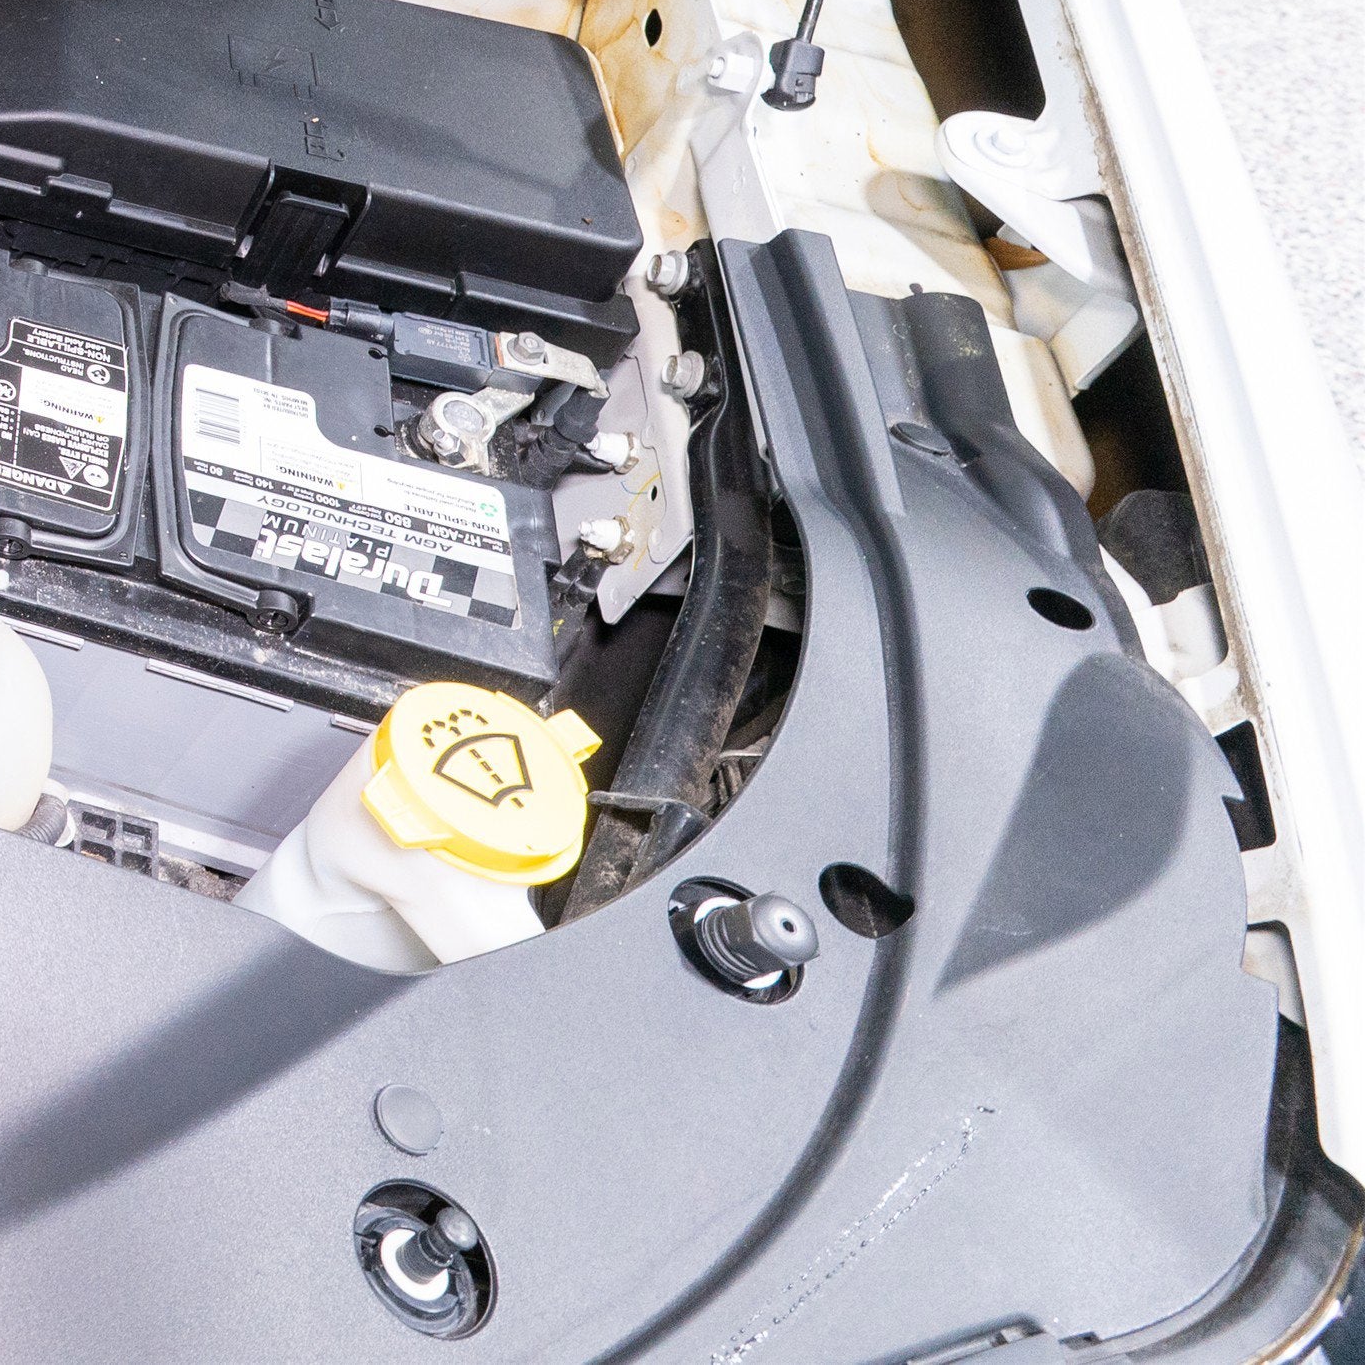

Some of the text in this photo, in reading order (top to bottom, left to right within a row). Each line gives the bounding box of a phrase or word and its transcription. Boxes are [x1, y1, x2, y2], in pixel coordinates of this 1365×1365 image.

[26, 333, 111, 362] NON-SPILLABLE
[31, 327, 106, 353] Lead Acid Battery
[22, 347, 84, 369] INSTRUCTIONS.
[60, 364, 83, 376] READ
[38, 399, 94, 420] WARNING:
[1, 430, 12, 439] NO
[22, 426, 40, 438] CAN
[34, 422, 109, 449] CAUSE BLINDNESS
[64, 425, 97, 440] INJURY.
[209, 464, 222, 476] 80
[275, 464, 333, 487] WARNING:
[255, 477, 273, 490] 140
[315, 493, 340, 507] 1000
[258, 495, 452, 553] AGM TECHNOLOGY
[384, 510, 412, 528] 850
[260, 512, 390, 558] PLATINUM
[426, 522, 481, 547] H7-AGM
[259, 526, 453, 608] Duralast
